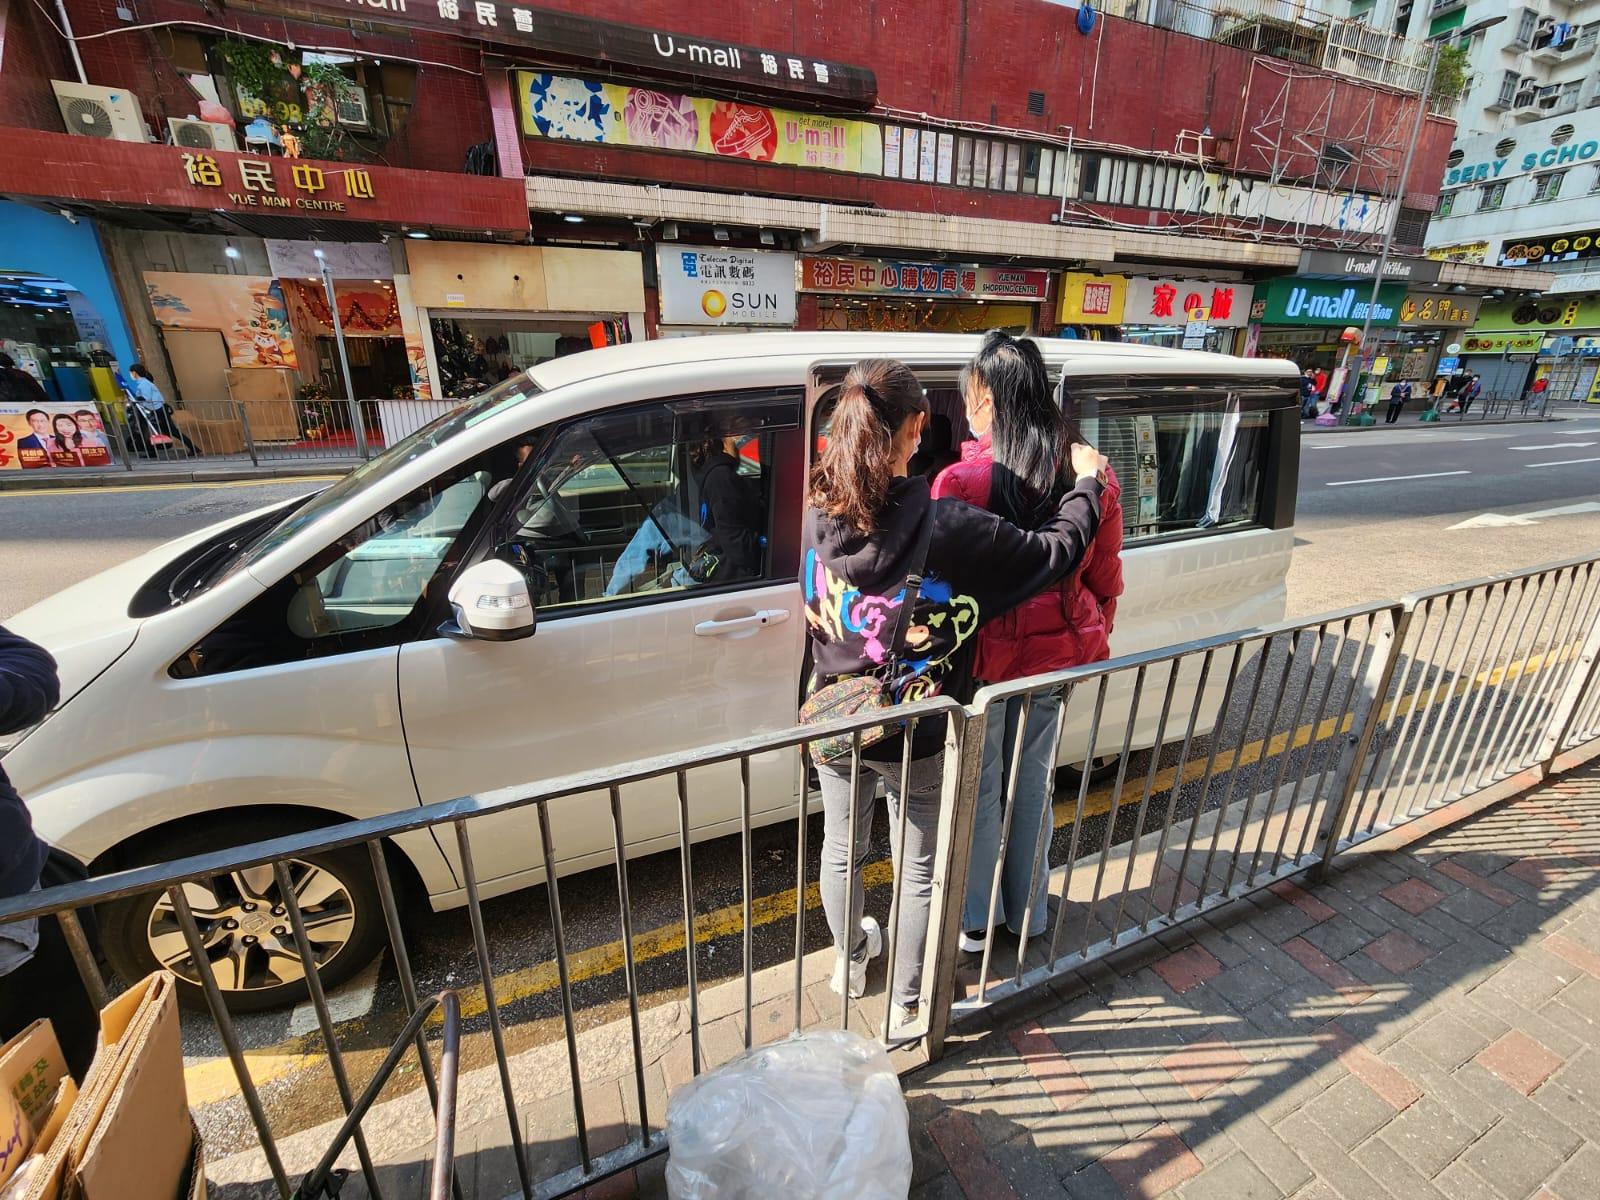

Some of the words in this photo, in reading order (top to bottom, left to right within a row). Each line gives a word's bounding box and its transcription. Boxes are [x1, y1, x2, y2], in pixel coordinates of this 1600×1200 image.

[653, 33, 741, 69] U-mall
[785, 121, 846, 149] U-mall
[1521, 140, 1599, 171] SCHO
[180, 152, 375, 199] 裕民中心
[228, 193, 257, 206] YUE
[262, 195, 291, 208] MAN
[296, 198, 346, 212] CENTRE
[699, 254, 728, 263] Telecom
[729, 255, 754, 265] Digital
[1344, 257, 1377, 274] U-mall
[700, 264, 755, 280] 電訊數碼
[813, 262, 976, 292] 裕民中心購物商場
[982, 283, 1015, 294] SHOPPING
[1015, 284, 1038, 294] CENTRE
[731, 292, 777, 309] SUN
[1285, 287, 1356, 319] U-mall
[732, 310, 777, 318] MOBILE
